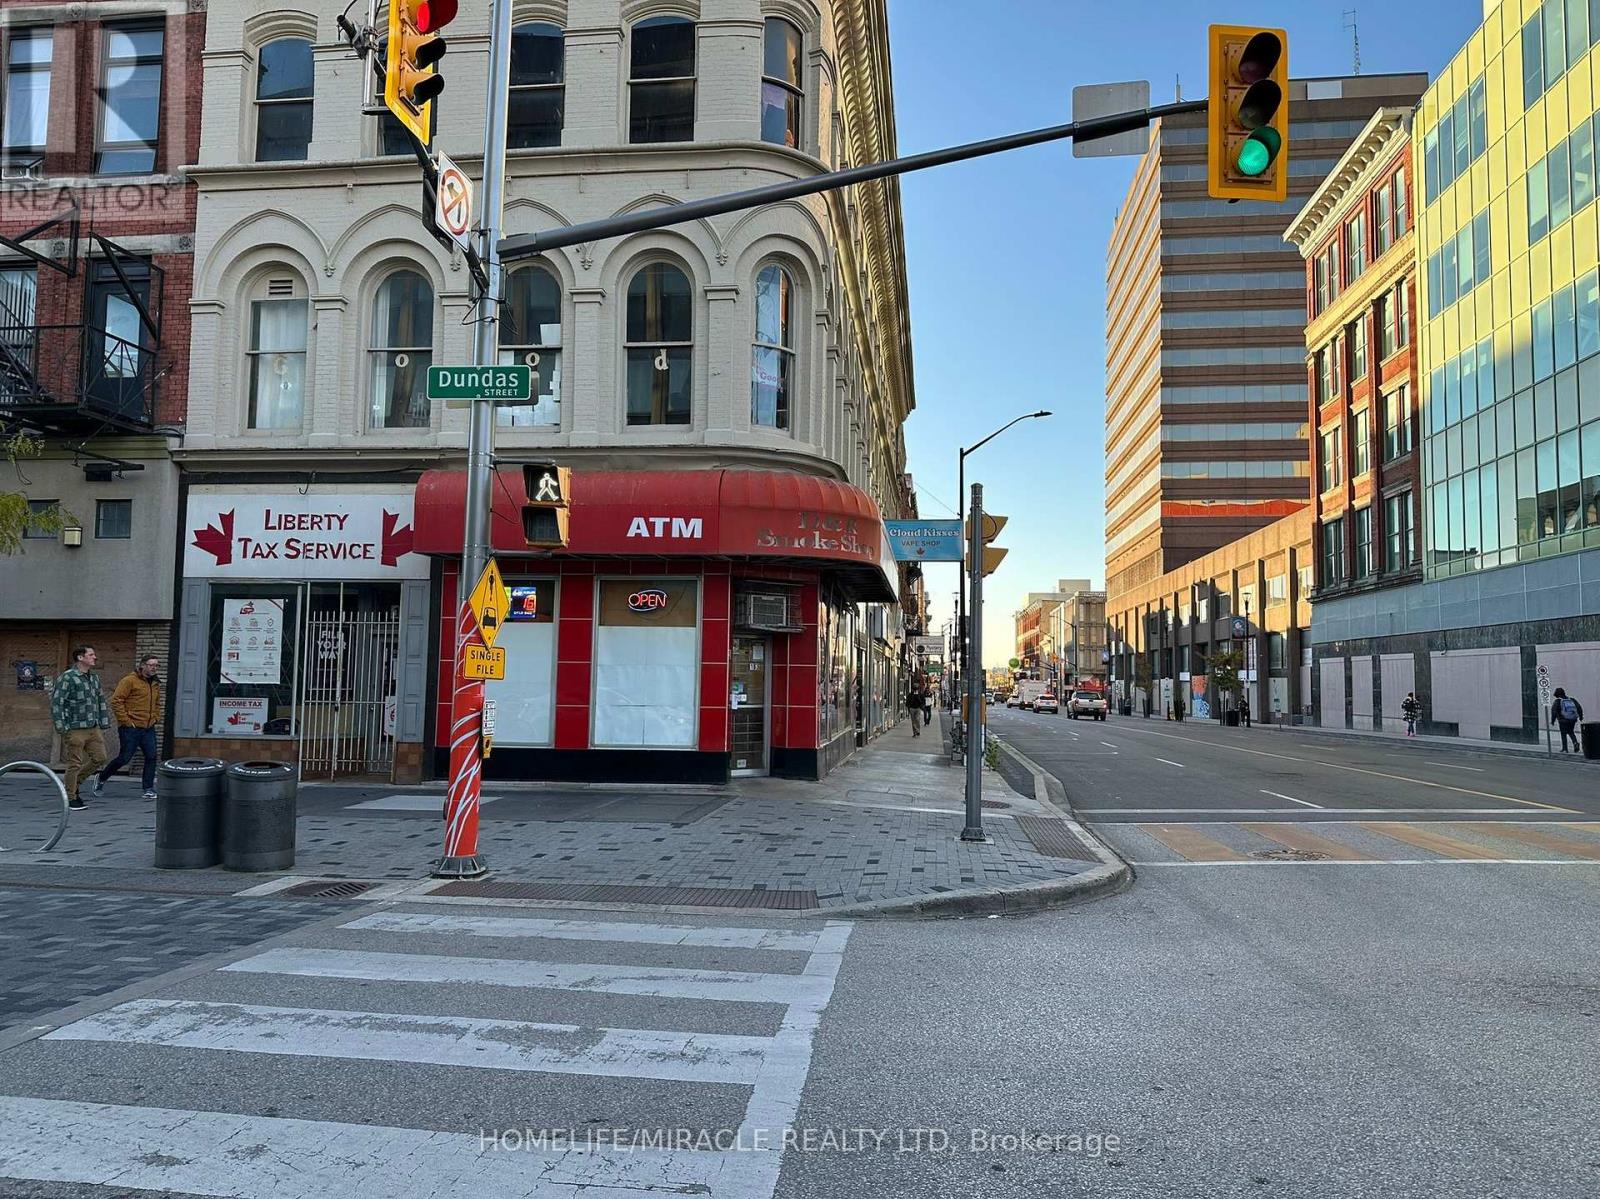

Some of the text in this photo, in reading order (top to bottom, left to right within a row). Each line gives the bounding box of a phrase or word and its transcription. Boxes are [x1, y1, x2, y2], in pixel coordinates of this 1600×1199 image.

[438, 369, 519, 388] Dundas
[484, 388, 518, 396] STREET
[626, 516, 703, 539] ATM
[889, 527, 960, 537] Cloud Kisses
[628, 593, 667, 607] OPEN
[470, 649, 501, 662] SINGLE
[476, 664, 494, 675] FILE
